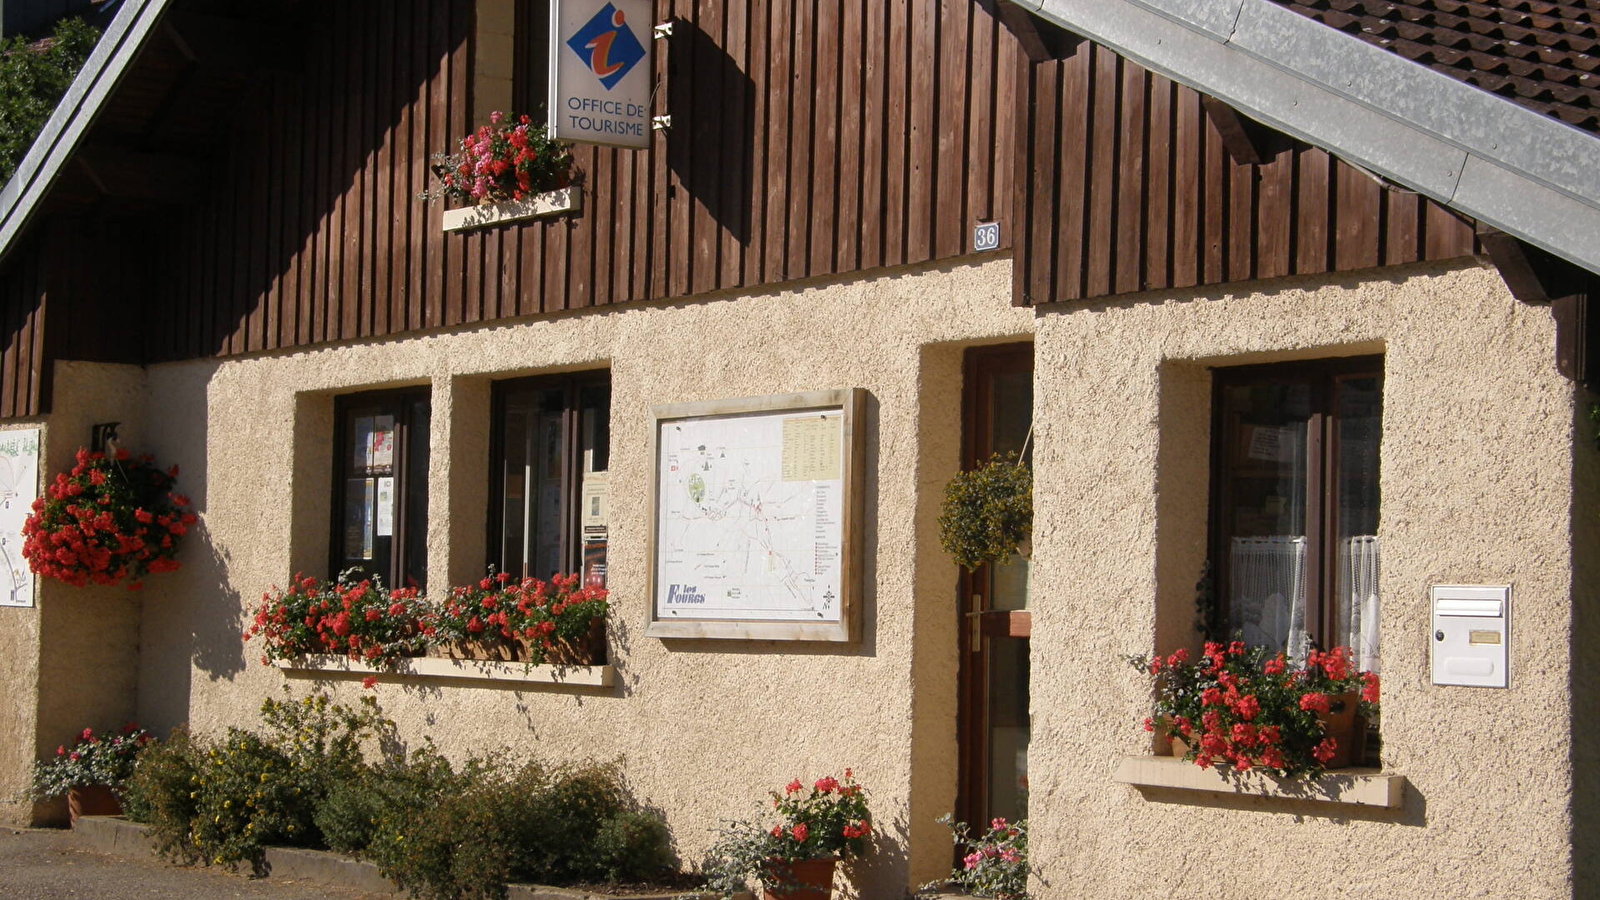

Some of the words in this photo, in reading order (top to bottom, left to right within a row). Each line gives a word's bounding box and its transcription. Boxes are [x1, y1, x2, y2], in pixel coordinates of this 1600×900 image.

[568, 97, 622, 115] OFFICE
[626, 104, 644, 118] DE
[569, 115, 643, 136] TOURISME
[977, 227, 996, 246] 36
